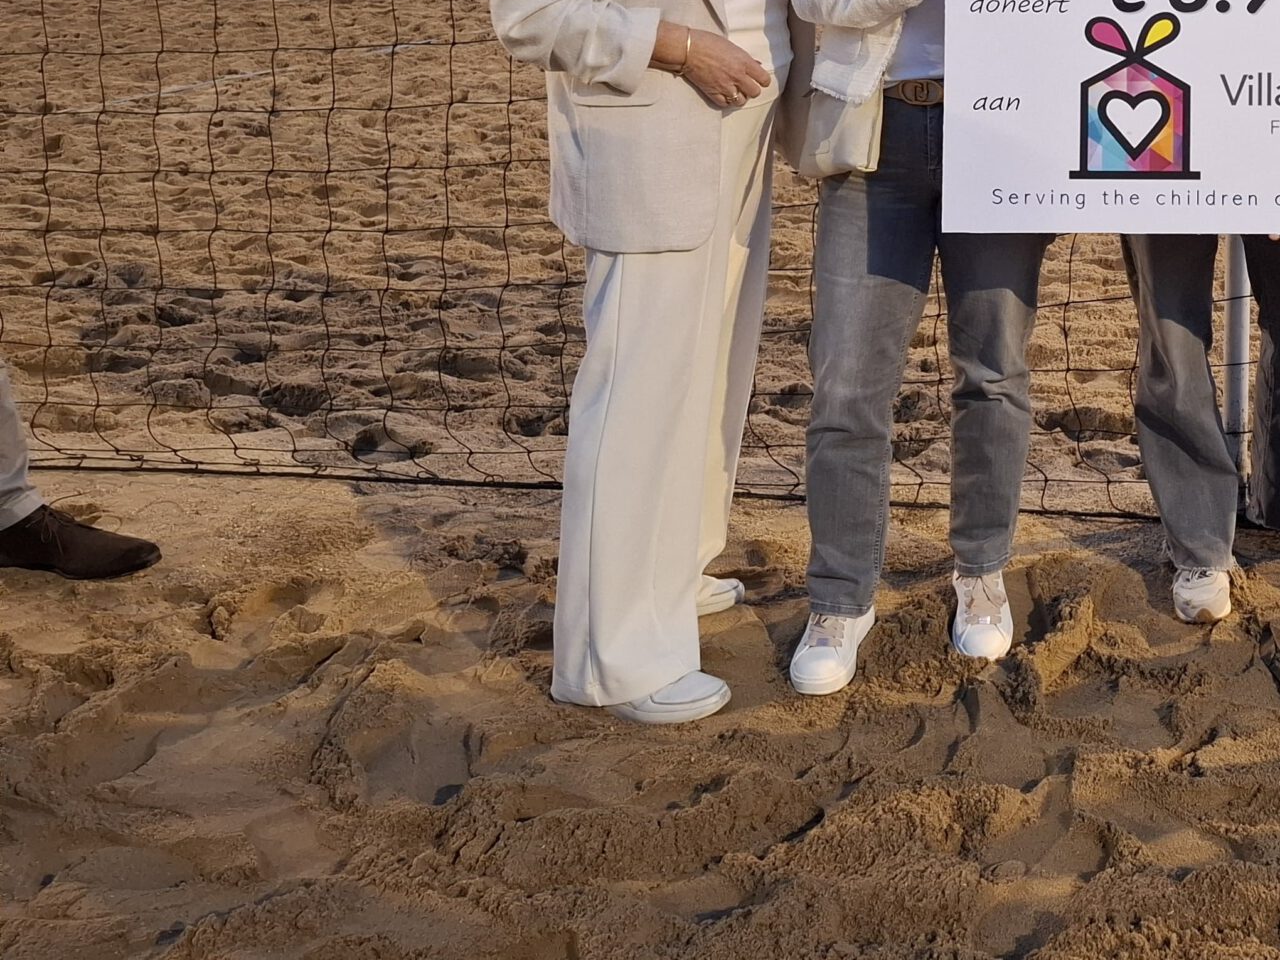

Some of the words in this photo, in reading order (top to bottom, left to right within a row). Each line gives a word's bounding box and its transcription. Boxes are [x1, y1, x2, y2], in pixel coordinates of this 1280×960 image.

[972, 96, 1021, 111] aan
[992, 188, 1086, 210] Serving
[1102, 189, 1140, 206] the
[1155, 189, 1258, 206] children
